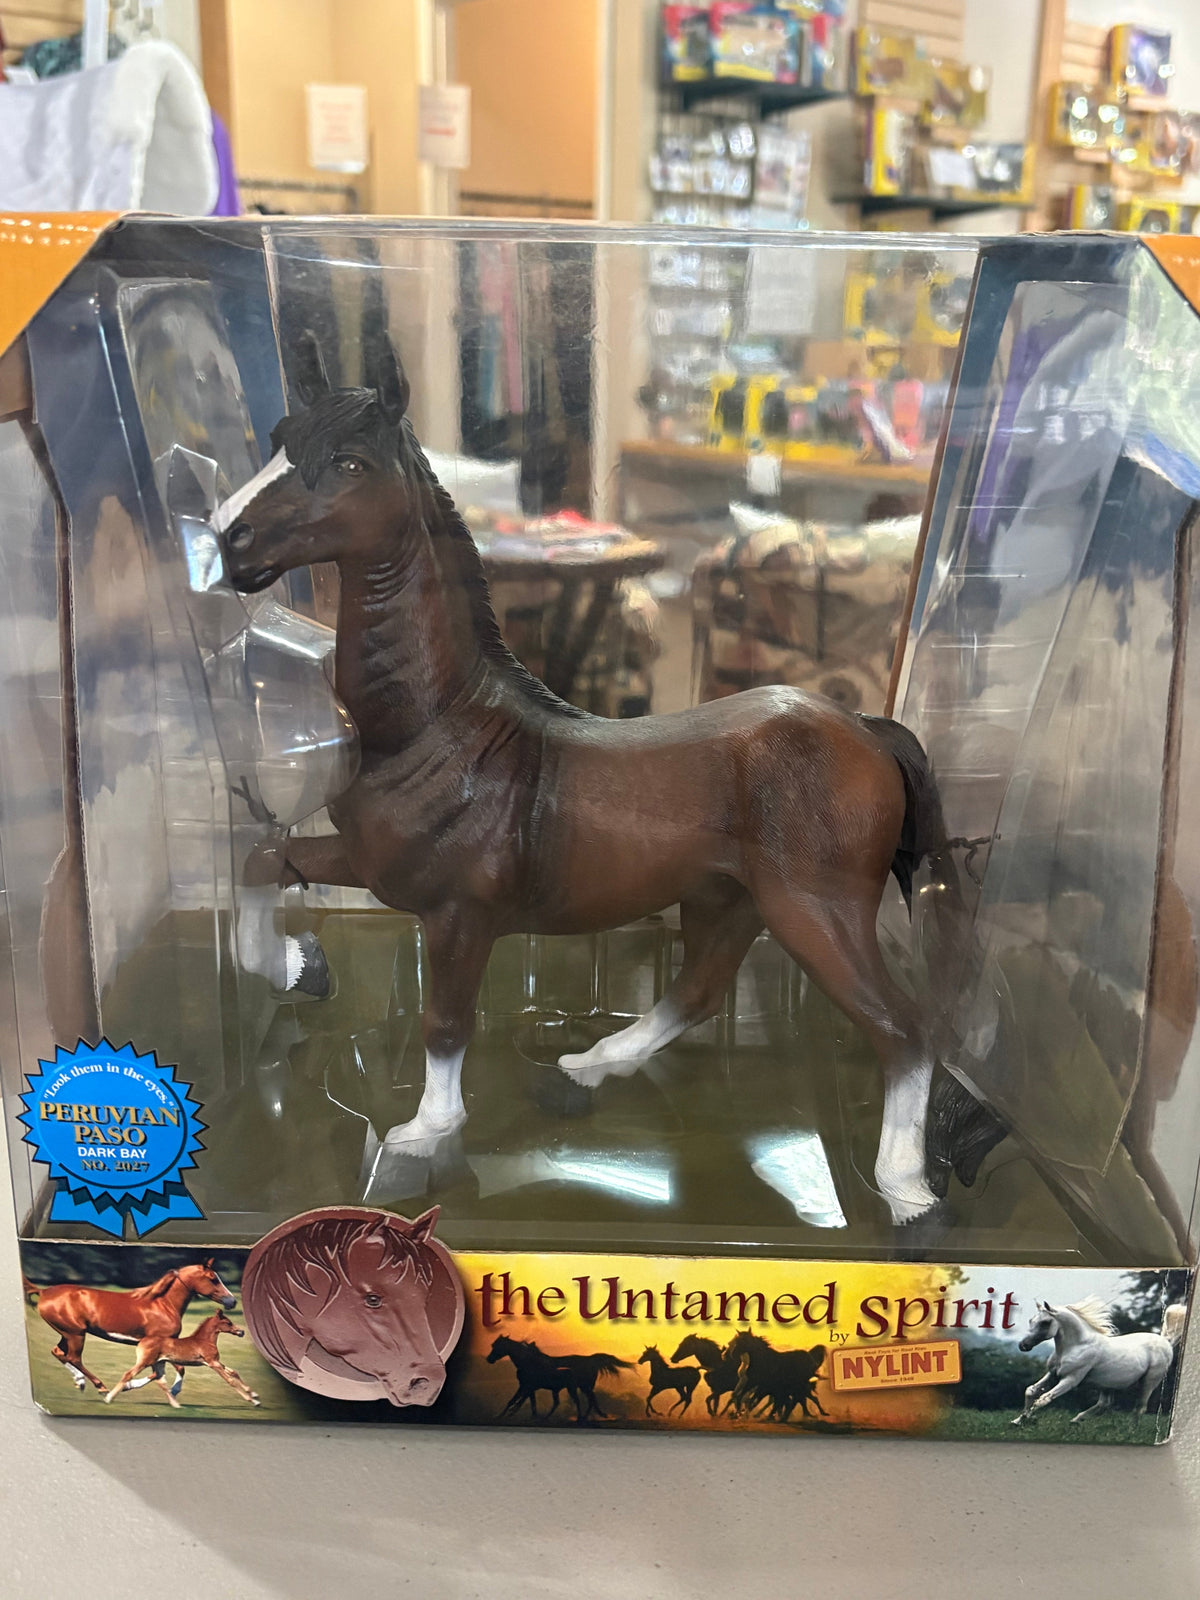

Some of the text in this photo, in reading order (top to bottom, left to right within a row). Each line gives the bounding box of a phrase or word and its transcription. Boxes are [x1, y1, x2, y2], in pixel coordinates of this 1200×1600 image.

[70, 1063, 103, 1078] them
[106, 1062, 120, 1073] in
[123, 1067, 144, 1082] the
[39, 1101, 181, 1127] PERUVIAN
[74, 1125, 147, 1146] PASO
[77, 1146, 147, 1159] DARK BAY
[81, 1159, 150, 1173] NO. 2027
[474, 1271, 1019, 1339] the Untamed Spirit
[829, 1329, 850, 1345] by
[842, 1350, 948, 1379] NYLINT
